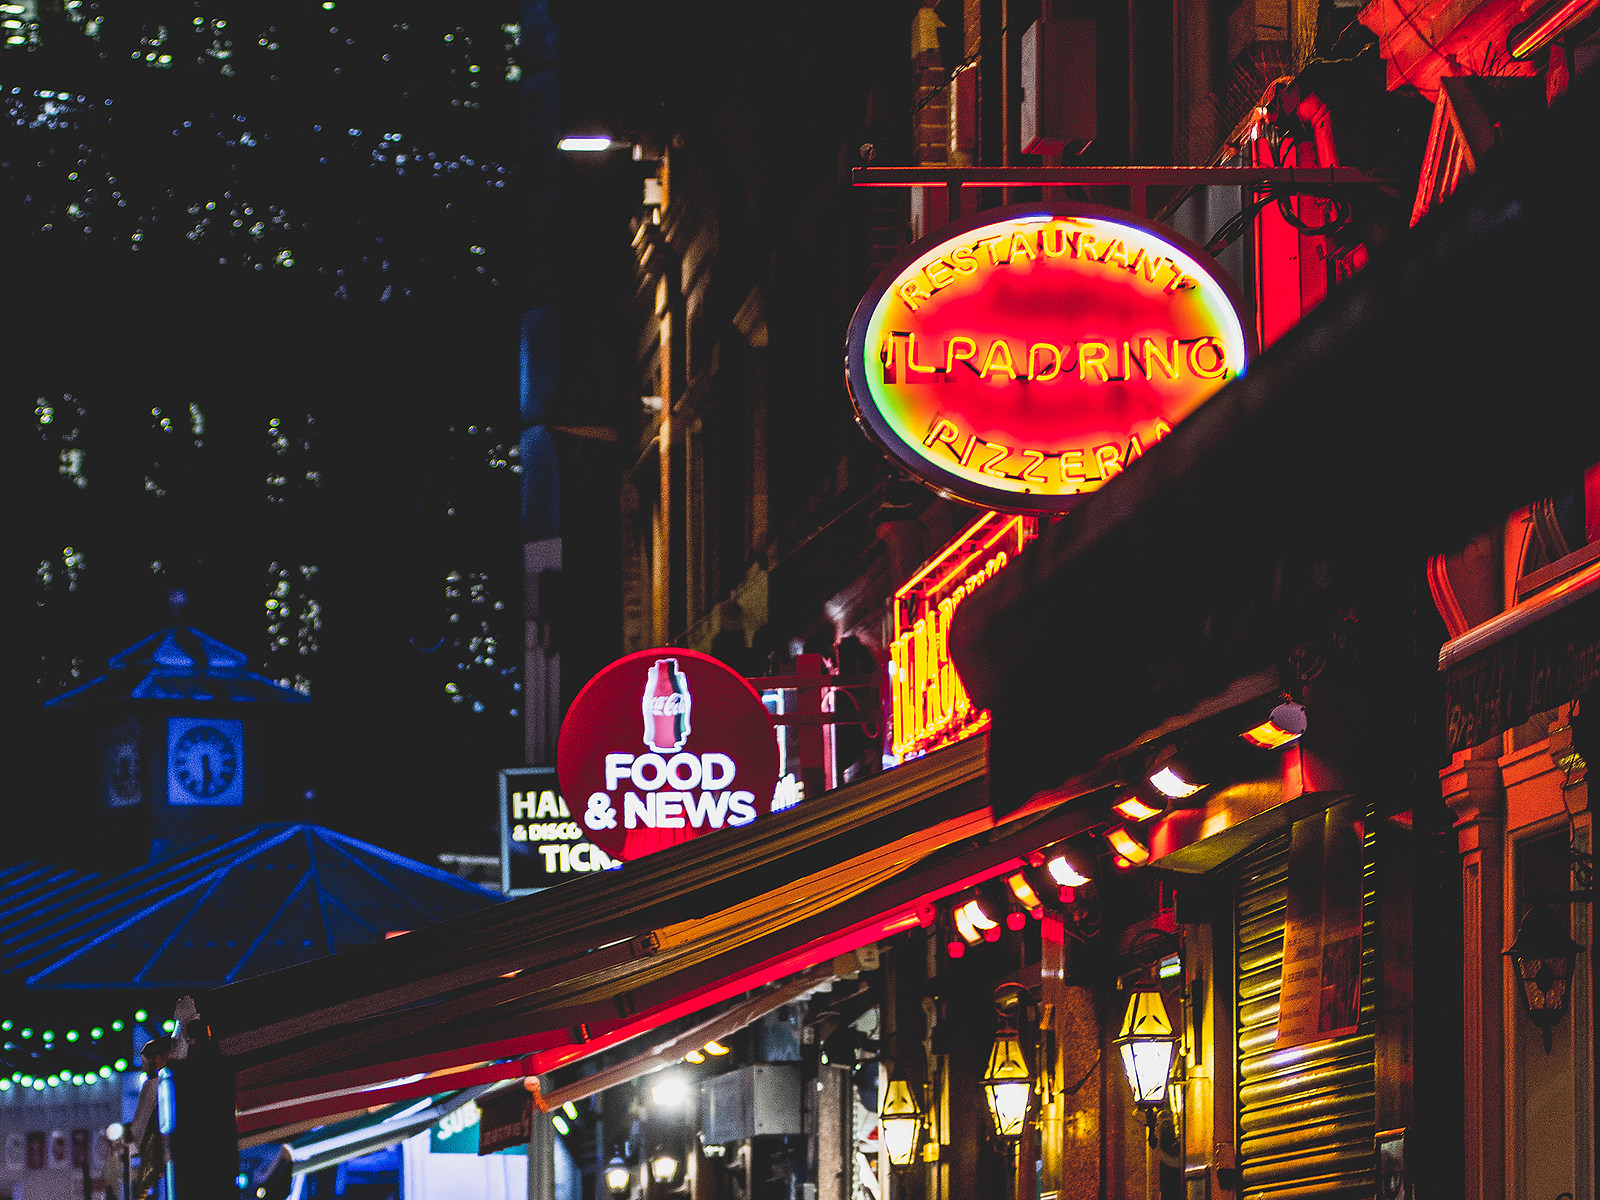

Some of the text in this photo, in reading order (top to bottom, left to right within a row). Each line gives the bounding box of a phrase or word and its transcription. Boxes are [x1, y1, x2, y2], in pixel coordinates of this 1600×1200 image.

[897, 230, 1197, 311] RESTAURANT
[604, 752, 737, 791] FOOD
[583, 791, 618, 831] &
[623, 791, 757, 829] NEWS
[512, 824, 528, 842] &
